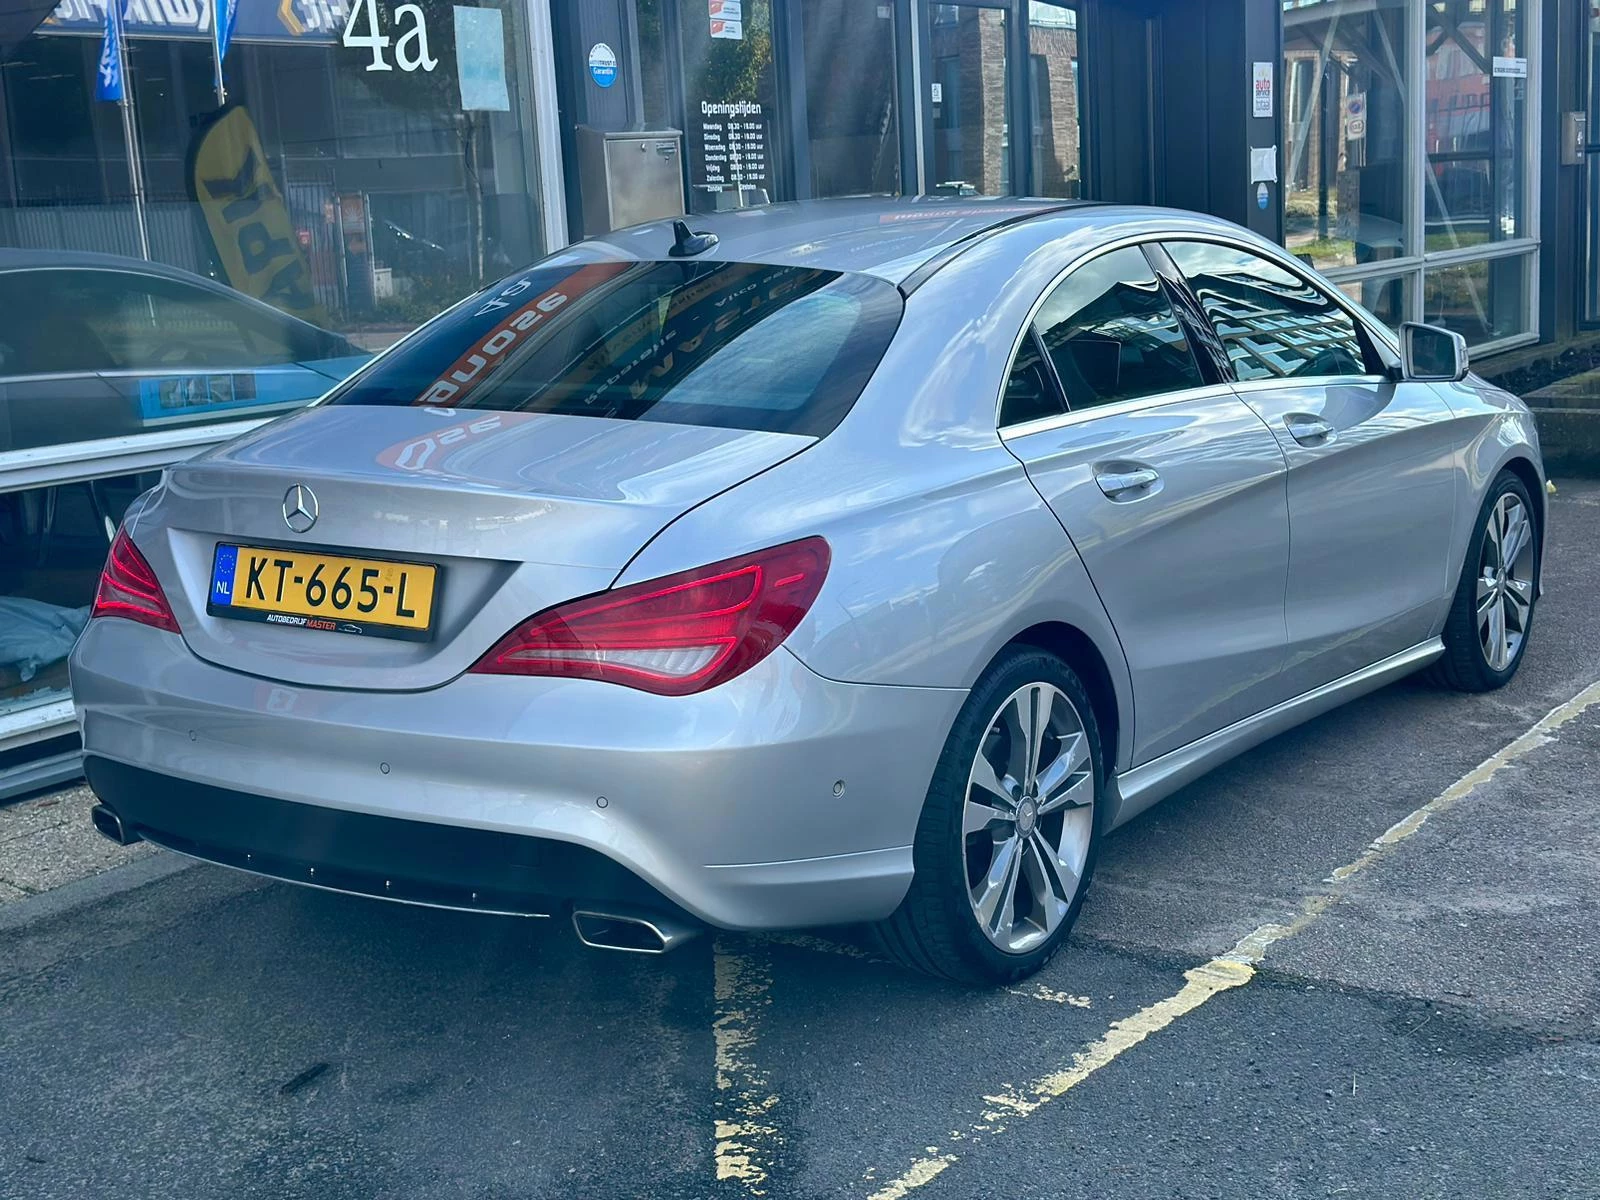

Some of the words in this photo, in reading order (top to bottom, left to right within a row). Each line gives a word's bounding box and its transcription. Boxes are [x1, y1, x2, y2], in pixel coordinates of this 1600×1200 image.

[343, 0, 438, 72] 4a
[701, 100, 762, 119] Openingstijden
[216, 580, 230, 595] NL
[245, 557, 415, 618] KT-665-L
[266, 613, 308, 626] AUTOBEDRIJF
[306, 619, 337, 631] MASTER
